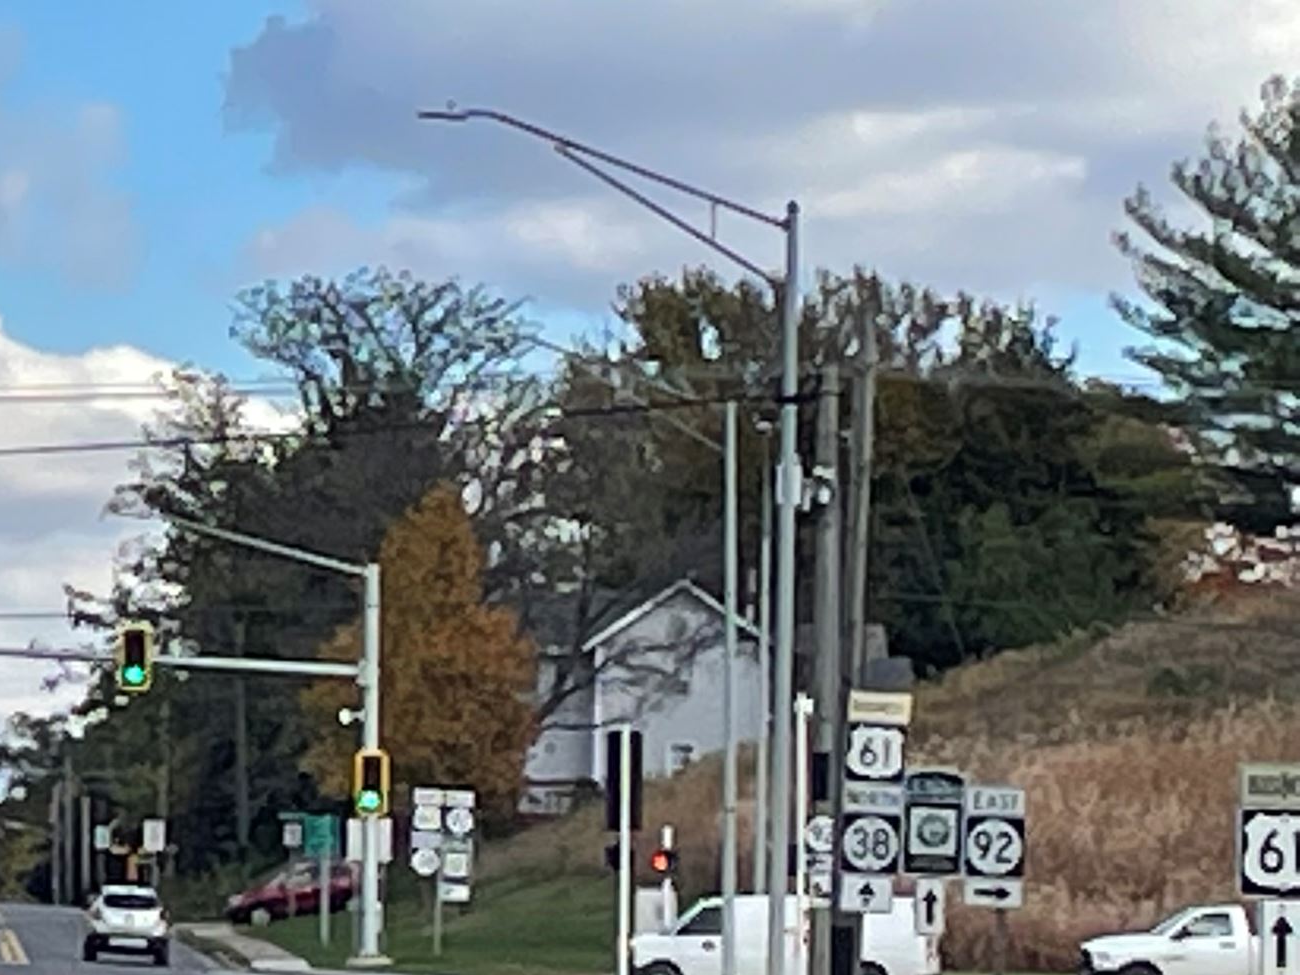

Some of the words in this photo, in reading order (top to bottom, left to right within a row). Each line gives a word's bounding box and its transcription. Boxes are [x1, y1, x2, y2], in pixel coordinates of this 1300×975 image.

[860, 738, 891, 767] 61
[973, 790, 1019, 810] EAST
[853, 827, 891, 861] 38
[973, 830, 1013, 864] 92
[1260, 828, 1300, 874] 61
